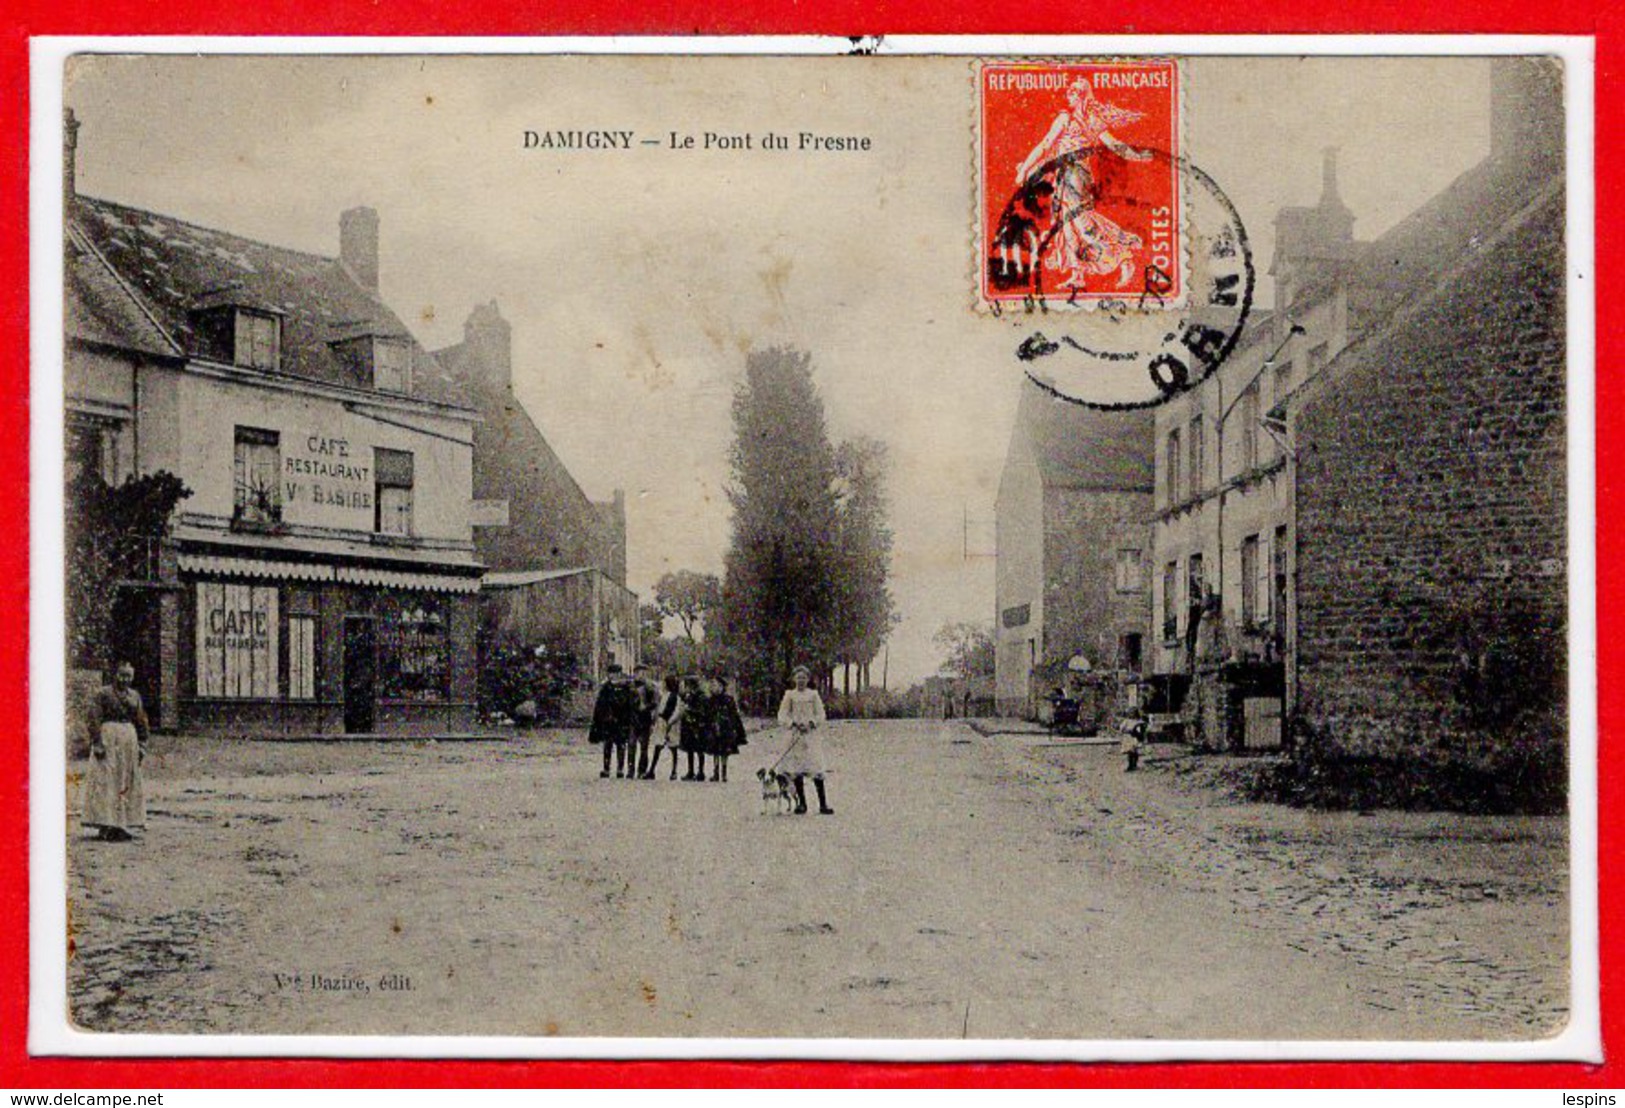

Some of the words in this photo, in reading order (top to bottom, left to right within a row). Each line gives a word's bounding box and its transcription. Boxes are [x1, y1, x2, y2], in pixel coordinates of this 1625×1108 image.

[1092, 71, 1169, 90] FRANÇAISE
[522, 130, 635, 150] DAMIGNY
[669, 131, 695, 150] Le
[703, 131, 752, 150] Pont
[761, 132, 789, 151] du
[798, 132, 872, 152] Fresne
[307, 435, 349, 458] CAFÉ
[285, 457, 369, 482] RESTAURANT
[311, 973, 371, 994] Bazire,
[379, 974, 417, 991] édit.
